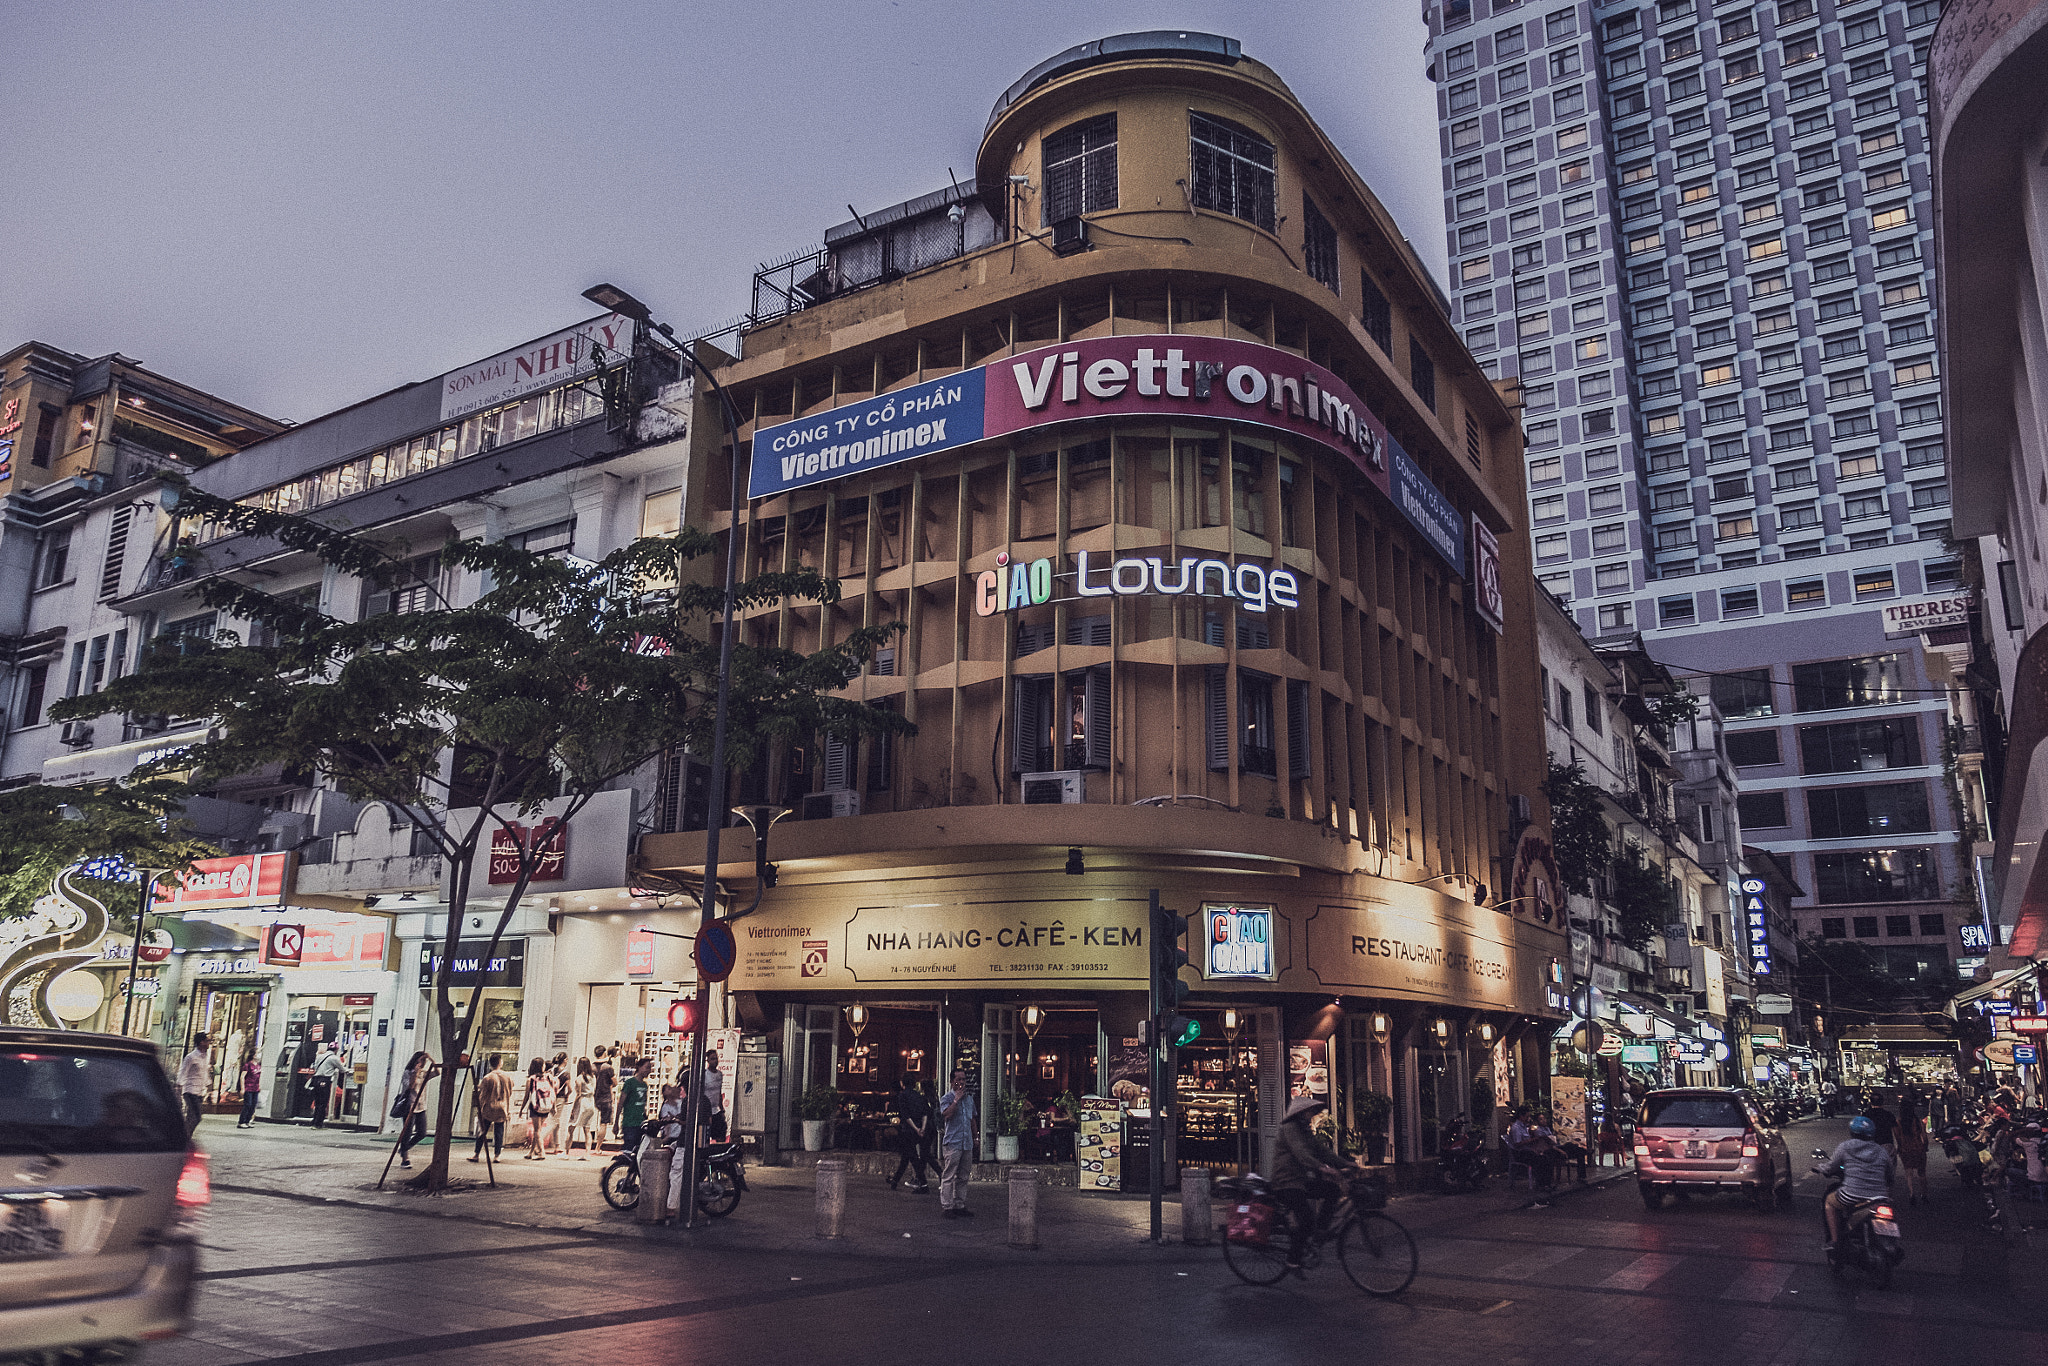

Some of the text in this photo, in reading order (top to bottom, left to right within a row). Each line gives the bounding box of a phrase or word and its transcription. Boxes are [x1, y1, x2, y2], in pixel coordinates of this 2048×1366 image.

[463, 399, 483, 412] 0913
[484, 393, 500, 404] 606
[502, 387, 517, 399] 525
[1013, 348, 1384, 472] Viettronimex
[772, 385, 962, 452] CÔNG TY CỔ PHẦN
[781, 418, 947, 481] Viettronimex
[1395, 455, 1417, 488] CÔNG
[1418, 480, 1427, 500] TY
[1400, 480, 1456, 561] Viettronimex
[1897, 613, 1968, 631] JEWELRY
[748, 925, 812, 938] Viettronimex
[1083, 927, 1142, 947] KEM
[1665, 926, 1686, 940] Spa
[1747, 896, 1769, 975] ANPHA
[1961, 925, 1987, 947] SPA
[431, 955, 479, 972] VNAM
[1352, 935, 1442, 967] RESTAURANT
[1071, 963, 1109, 971] 39103532
